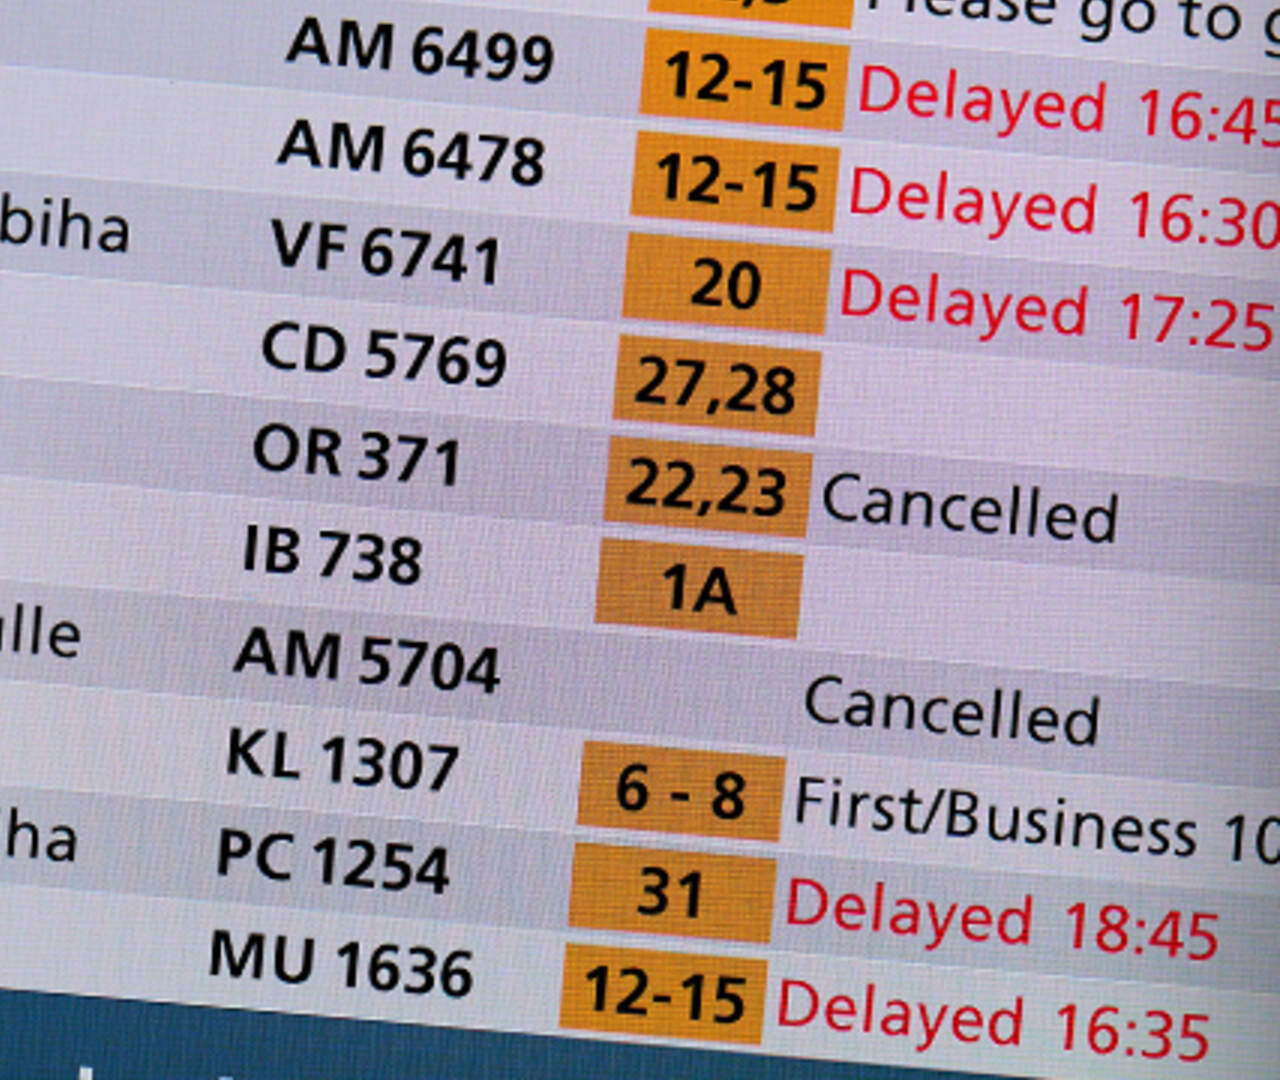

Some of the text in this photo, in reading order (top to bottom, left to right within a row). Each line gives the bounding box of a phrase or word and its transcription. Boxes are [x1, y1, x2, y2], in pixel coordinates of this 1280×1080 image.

[285, 16, 395, 71] AM
[411, 25, 555, 85] 6499
[666, 50, 828, 112] 12-15
[858, 63, 1108, 140] Delayed
[276, 118, 386, 173] AM
[402, 127, 546, 187] 6478
[657, 152, 819, 213] 12-15
[849, 166, 1098, 241] Delayed
[1130, 190, 1280, 252] 16:30
[270, 217, 348, 271] VF
[360, 226, 499, 285] 6741
[690, 256, 762, 311] 20
[840, 267, 1090, 343] Delayed
[1121, 292, 1276, 353] 17:25
[261, 320, 347, 373] CD
[364, 328, 508, 389] 5769
[633, 354, 797, 417] 27,28
[252, 421, 343, 477] OR
[356, 430, 460, 487] 371
[624, 456, 787, 518] 22,23
[822, 471, 1119, 545] Cancelled
[243, 523, 301, 575] IB
[318, 529, 423, 586] 738
[662, 562, 739, 617] 1A
[232, 625, 342, 681] AM
[358, 635, 502, 695] 5704
[804, 674, 1101, 747] Cancelled
[226, 726, 301, 780] KL
[321, 735, 460, 792] 1307
[795, 775, 1198, 858] First/Business
[216, 827, 296, 882] PC
[312, 836, 451, 896] 1254
[636, 865, 702, 920] 31
[785, 876, 1034, 952] Delayed
[1066, 901, 1220, 962] 18:45
[209, 928, 316, 985] MU
[336, 940, 474, 999] 1636
[585, 964, 748, 1026] 12-15
[777, 978, 1024, 1053] Delayed
[1056, 1002, 1210, 1064] 16:35
